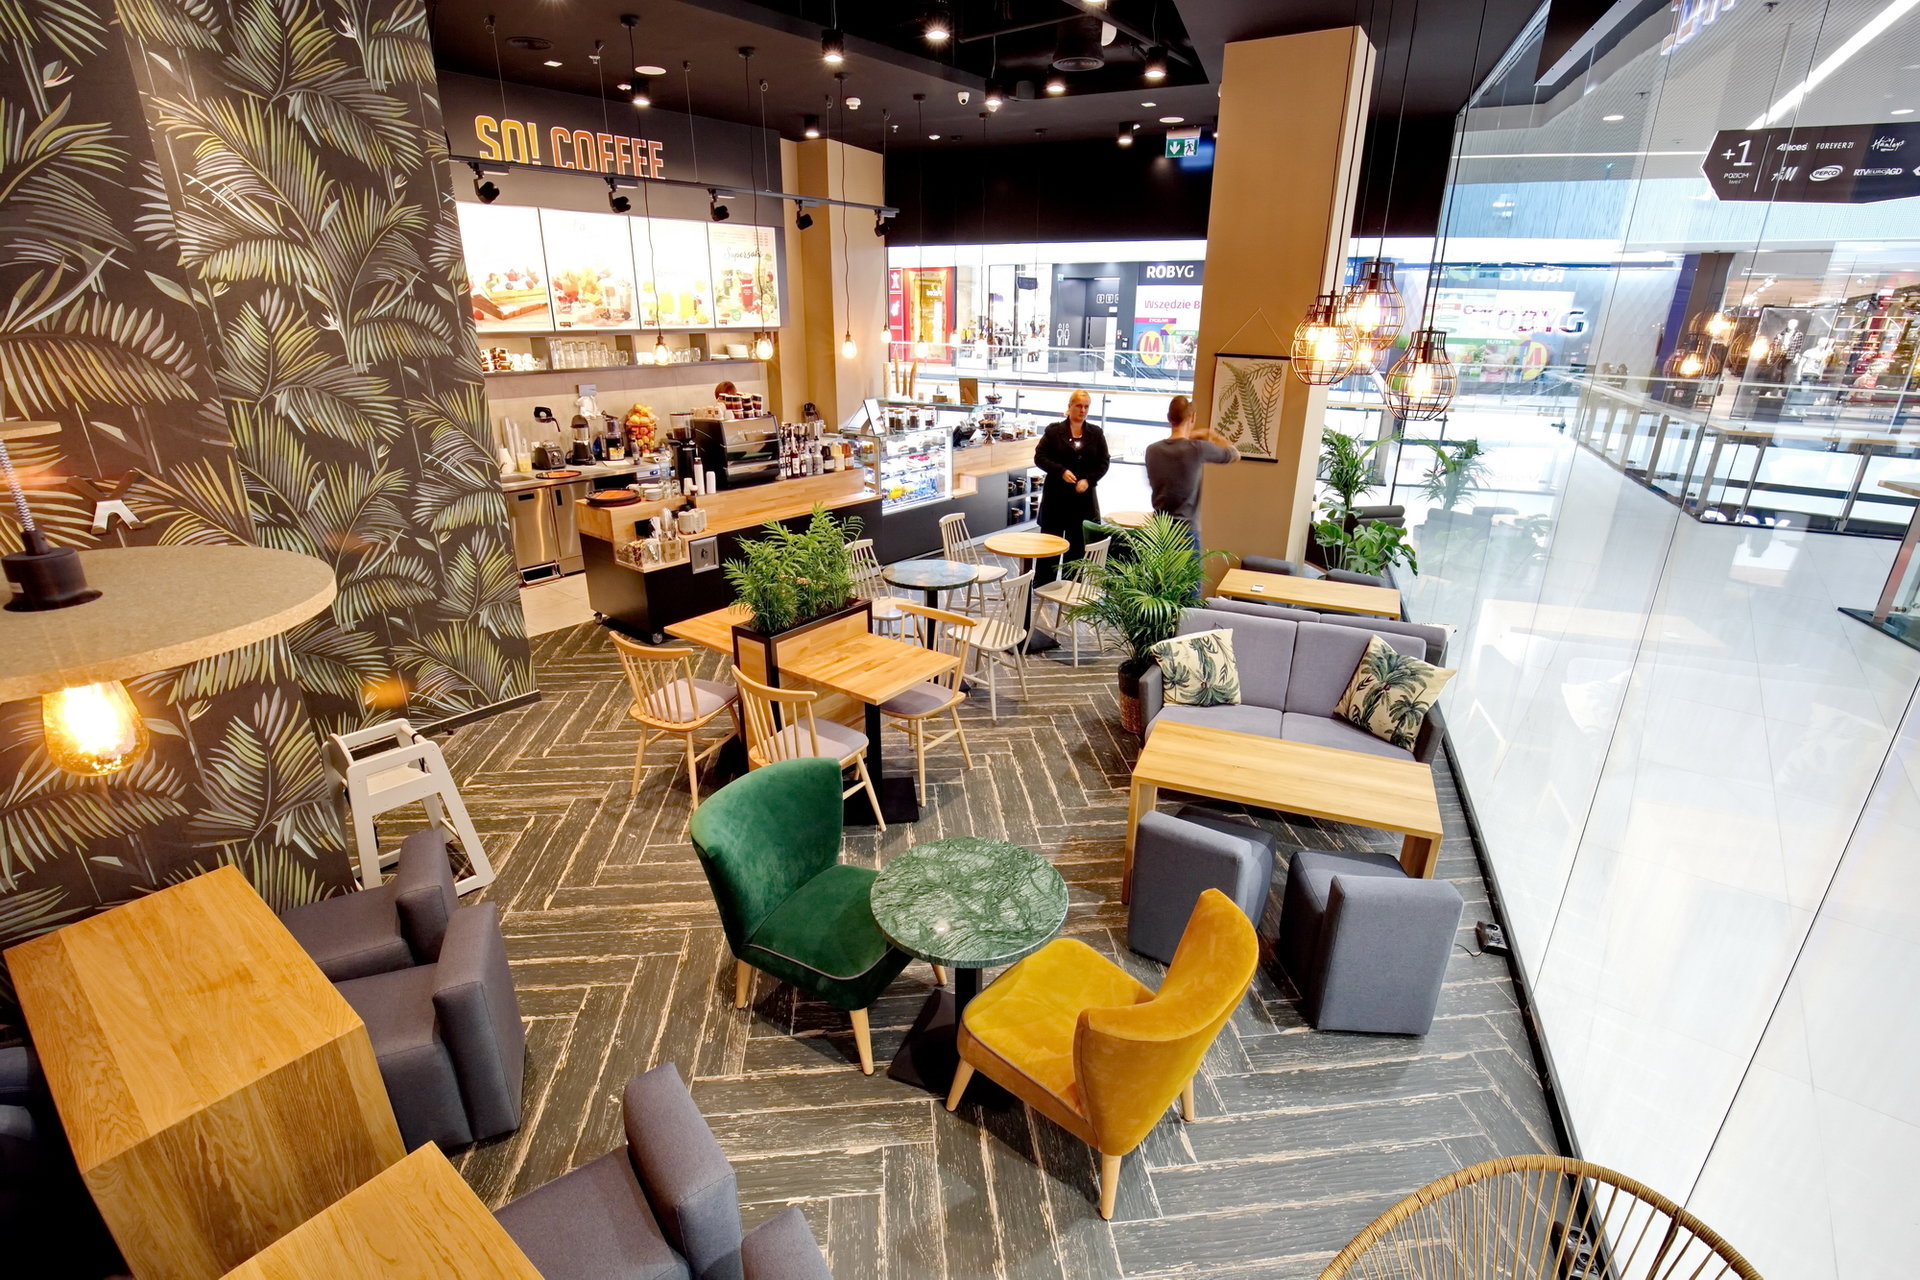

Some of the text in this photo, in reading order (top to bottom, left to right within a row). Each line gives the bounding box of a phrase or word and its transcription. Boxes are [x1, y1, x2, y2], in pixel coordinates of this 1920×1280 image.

[474, 115, 666, 180] SO! COFFEE
[1721, 139, 1756, 167] +1
[1146, 264, 1195, 279] ROBYG
[1144, 299, 1192, 312] Wszędzie
